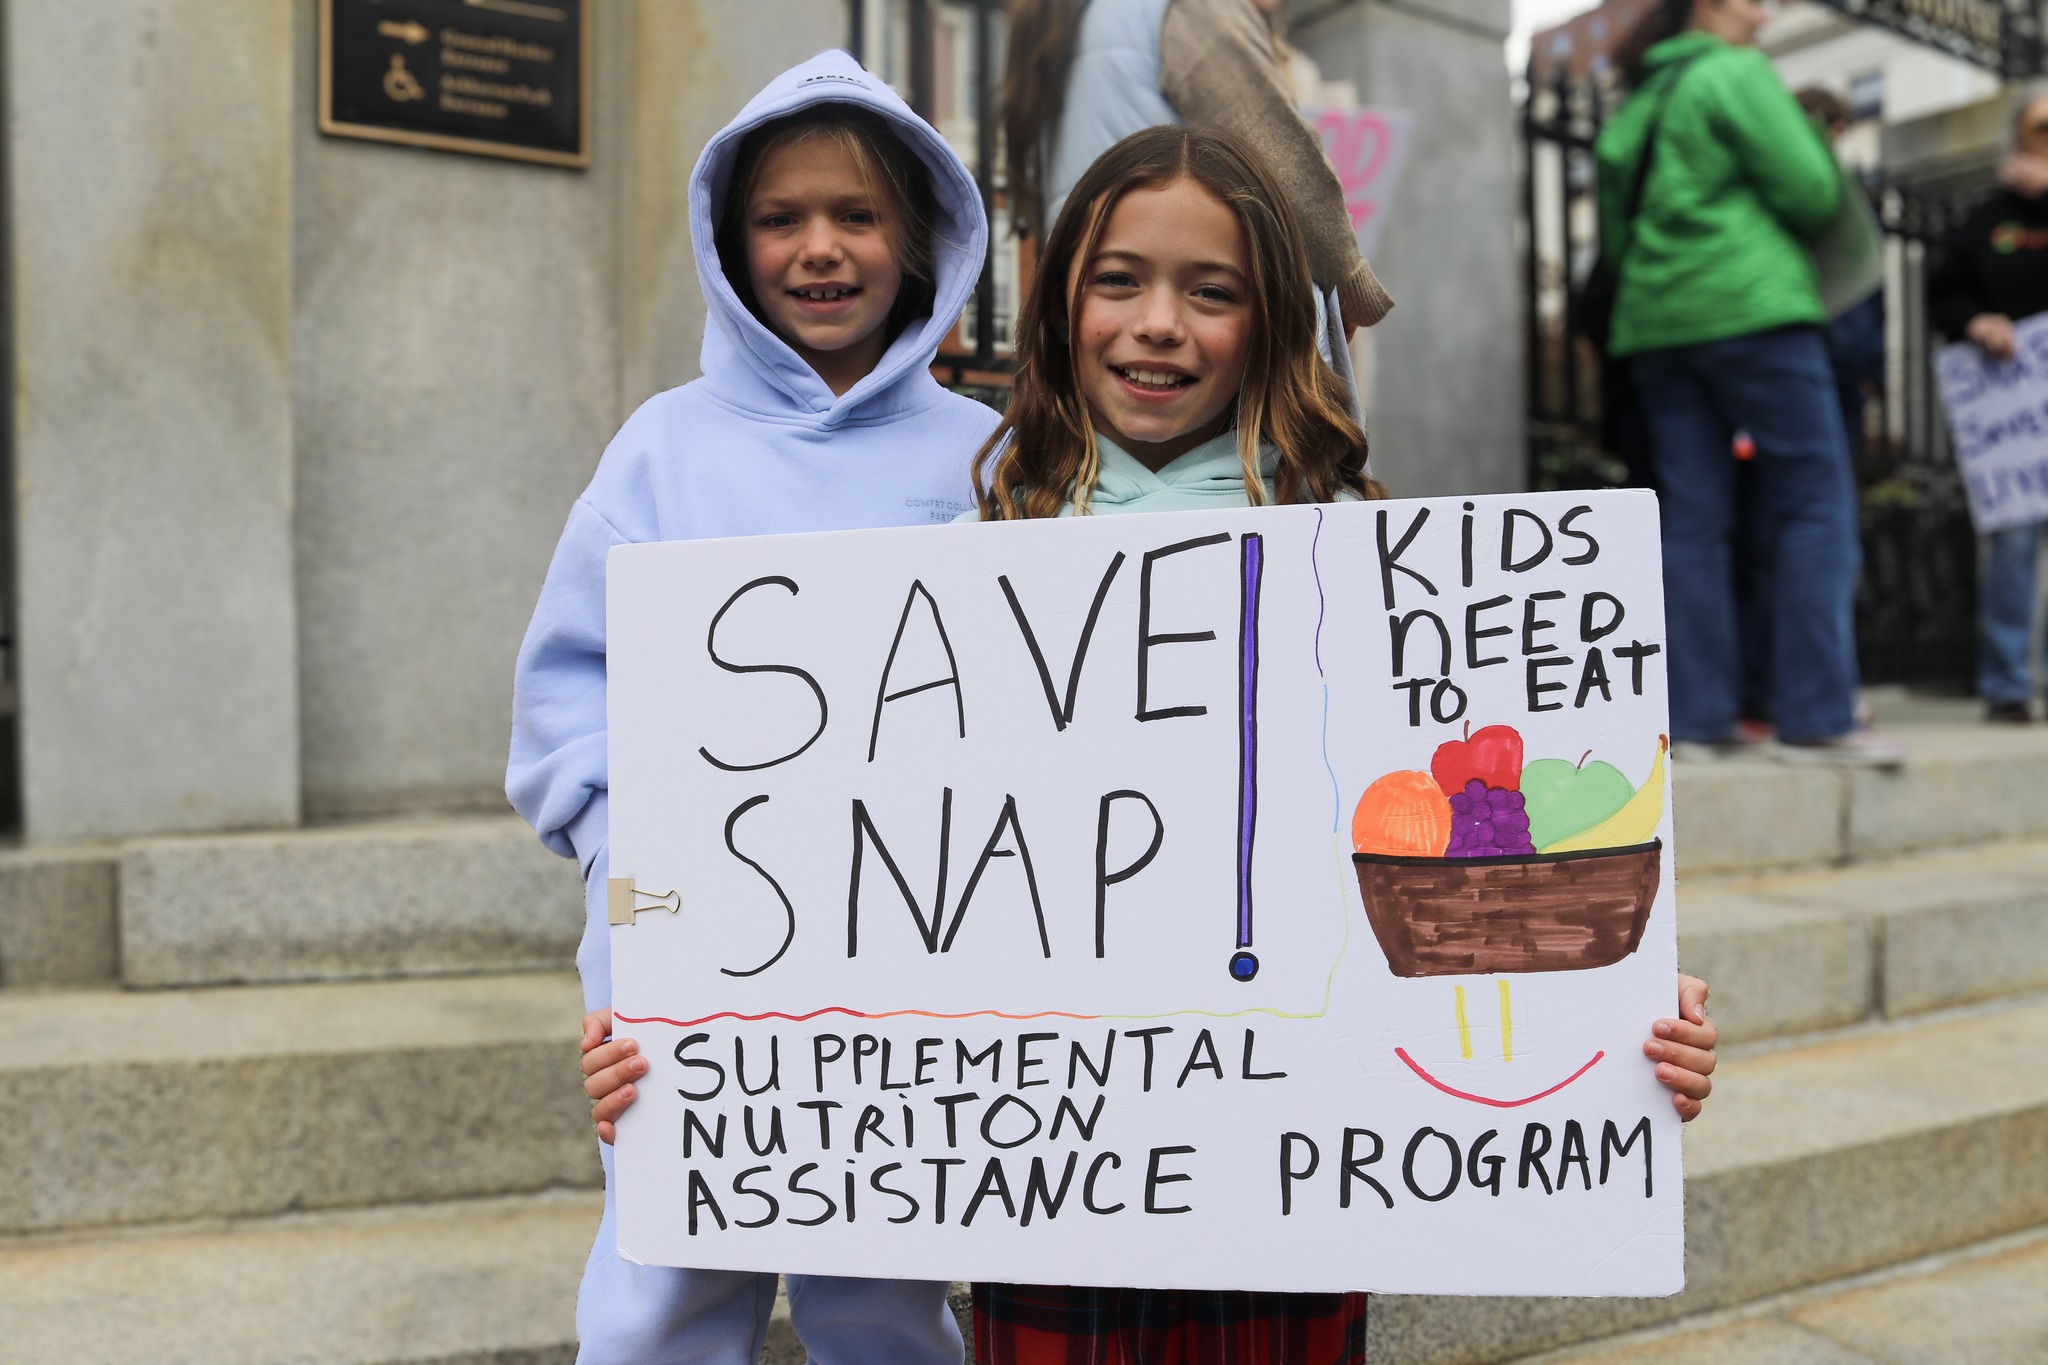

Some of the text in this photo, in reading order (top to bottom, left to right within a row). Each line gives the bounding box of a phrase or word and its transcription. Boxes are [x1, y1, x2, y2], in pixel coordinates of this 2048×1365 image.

[905, 499, 945, 509] COMFRT
[930, 512, 957, 522] PASTE
[699, 532, 1233, 771] SAVE
[1393, 640, 1660, 726] TO EAT
[720, 787, 1165, 977] SNAP
[1280, 1116, 1653, 1216] PROGRAM
